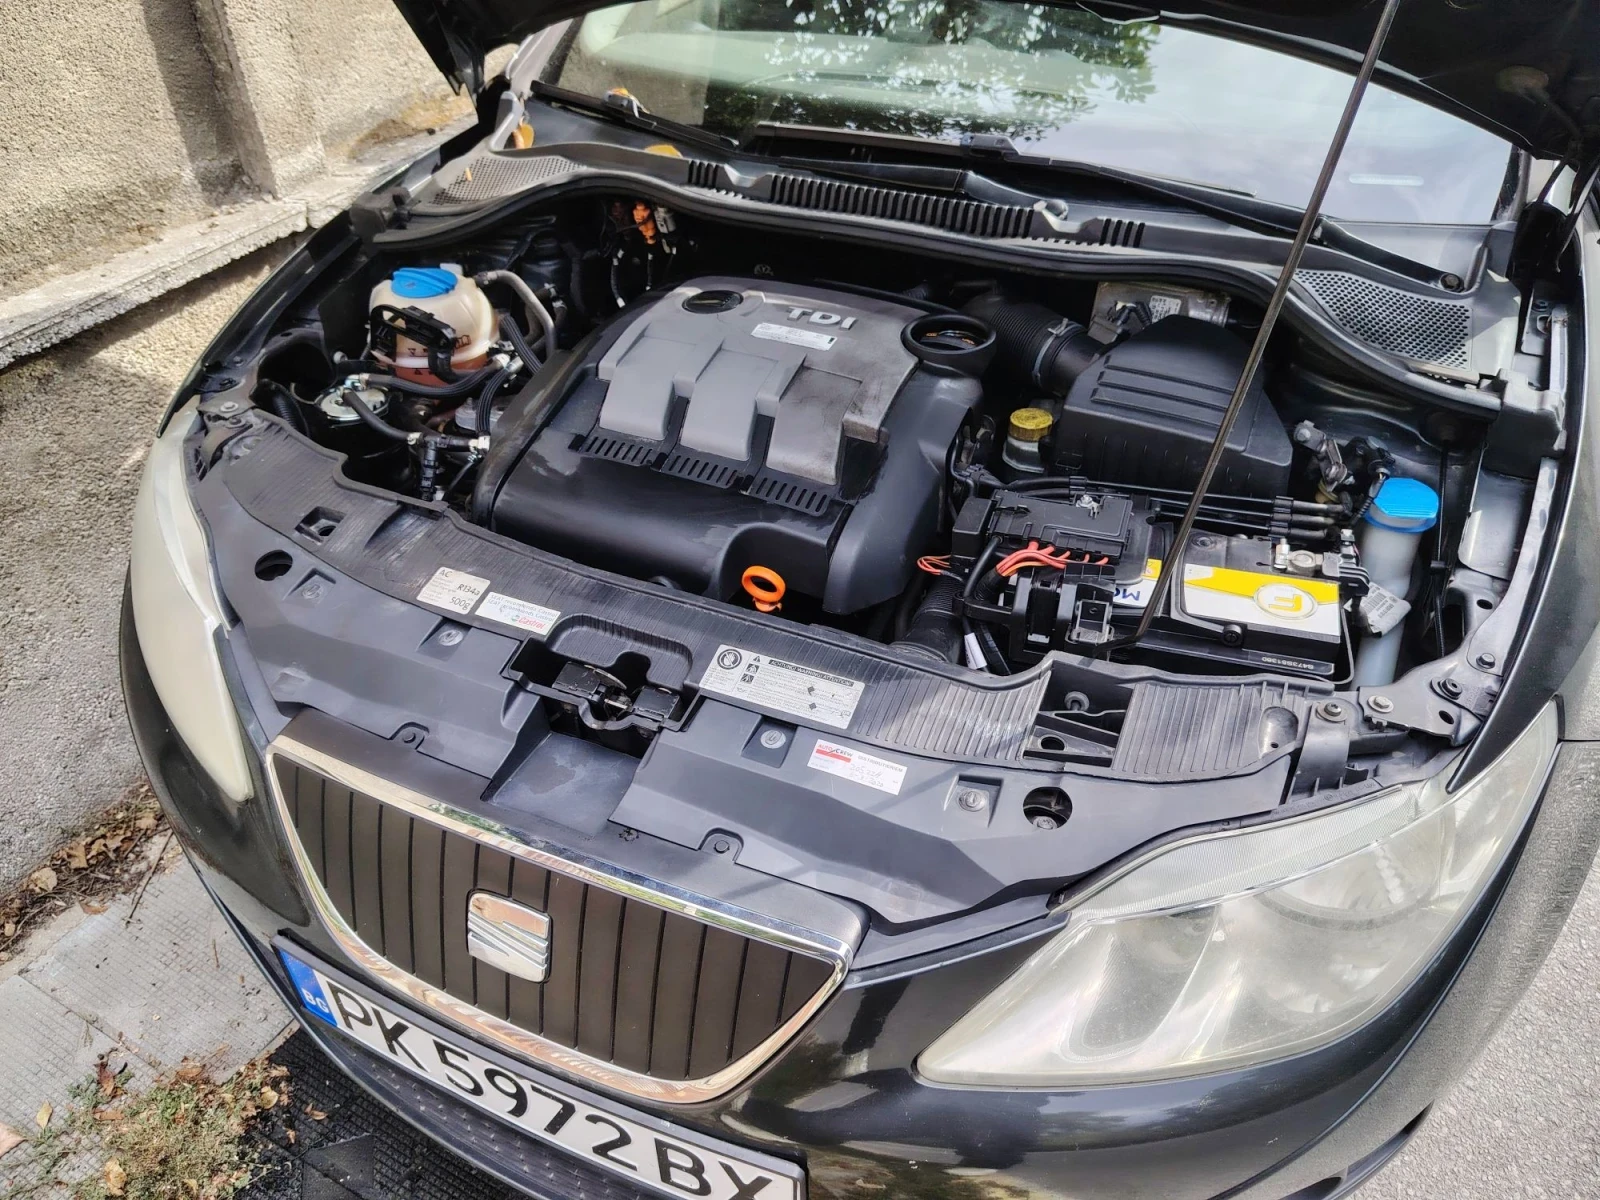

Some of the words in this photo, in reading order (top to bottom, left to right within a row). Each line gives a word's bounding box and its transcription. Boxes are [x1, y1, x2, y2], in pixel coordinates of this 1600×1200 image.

[787, 306, 857, 330] TDI
[439, 569, 452, 578] AC
[457, 583, 481, 596] R134a
[449, 596, 471, 610] 500g
[518, 617, 546, 630] Castrol
[305, 989, 330, 1014] BG
[328, 983, 428, 1073] PK
[434, 1045, 637, 1171] 5972
[654, 1138, 773, 1200] BX
